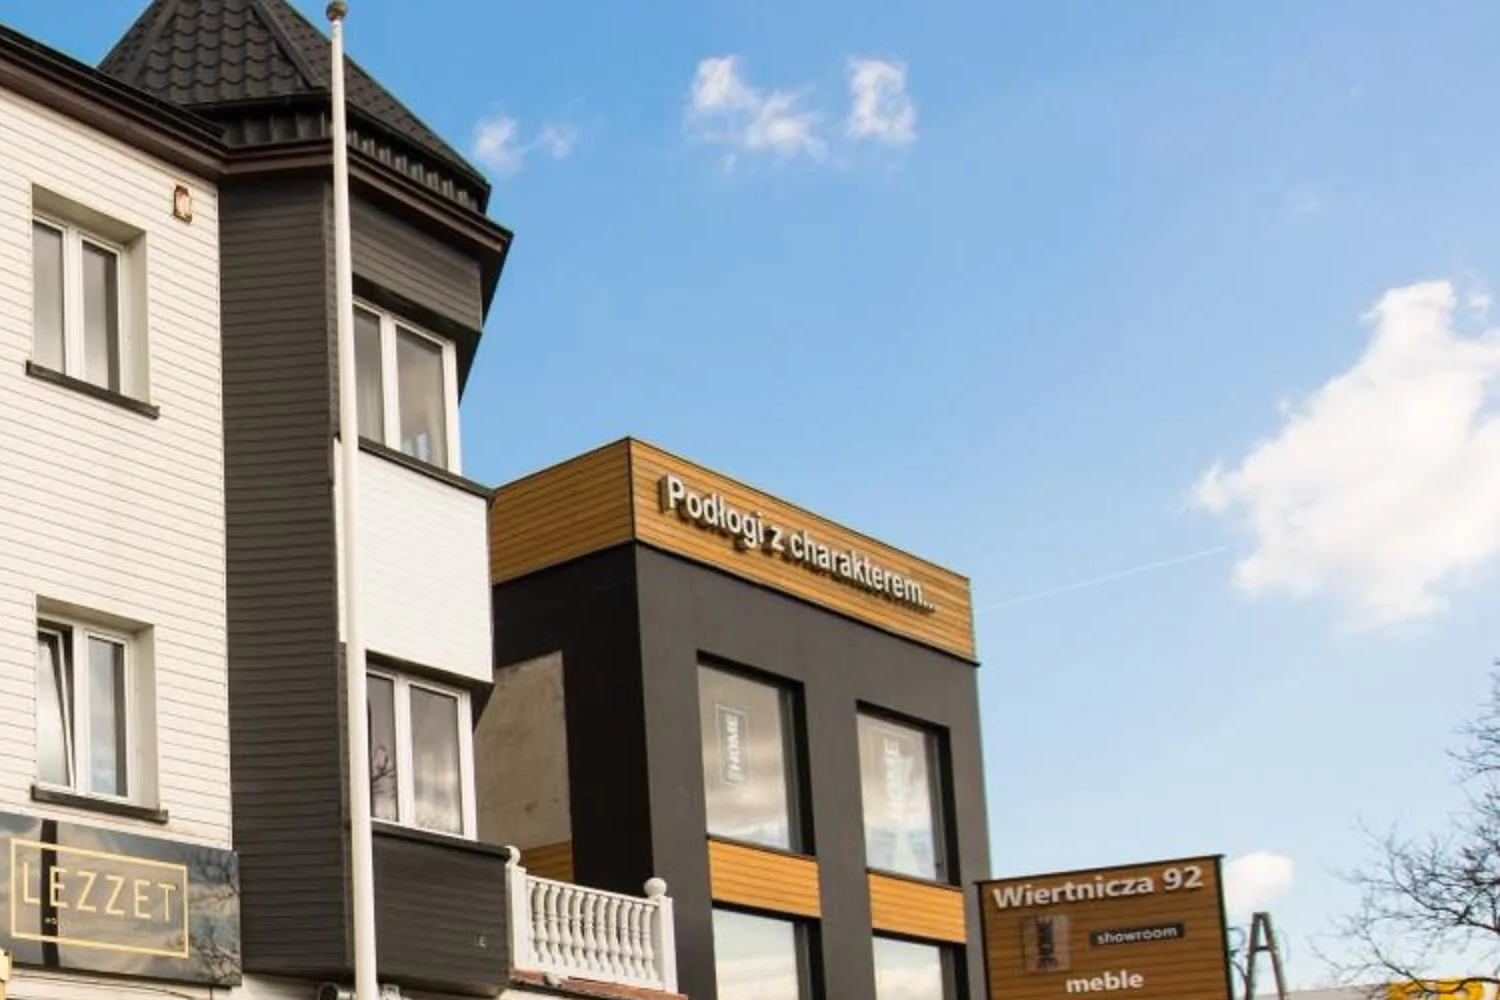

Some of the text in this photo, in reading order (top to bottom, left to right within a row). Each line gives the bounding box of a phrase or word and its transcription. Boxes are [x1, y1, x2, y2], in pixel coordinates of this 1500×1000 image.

[661, 473, 766, 549] Podłogi
[770, 524, 785, 552] z
[22, 861, 178, 923] LEZZET
[993, 865, 1204, 910] Wiertnicza 92
[1096, 926, 1178, 946] showroom
[1066, 969, 1144, 993] meble
